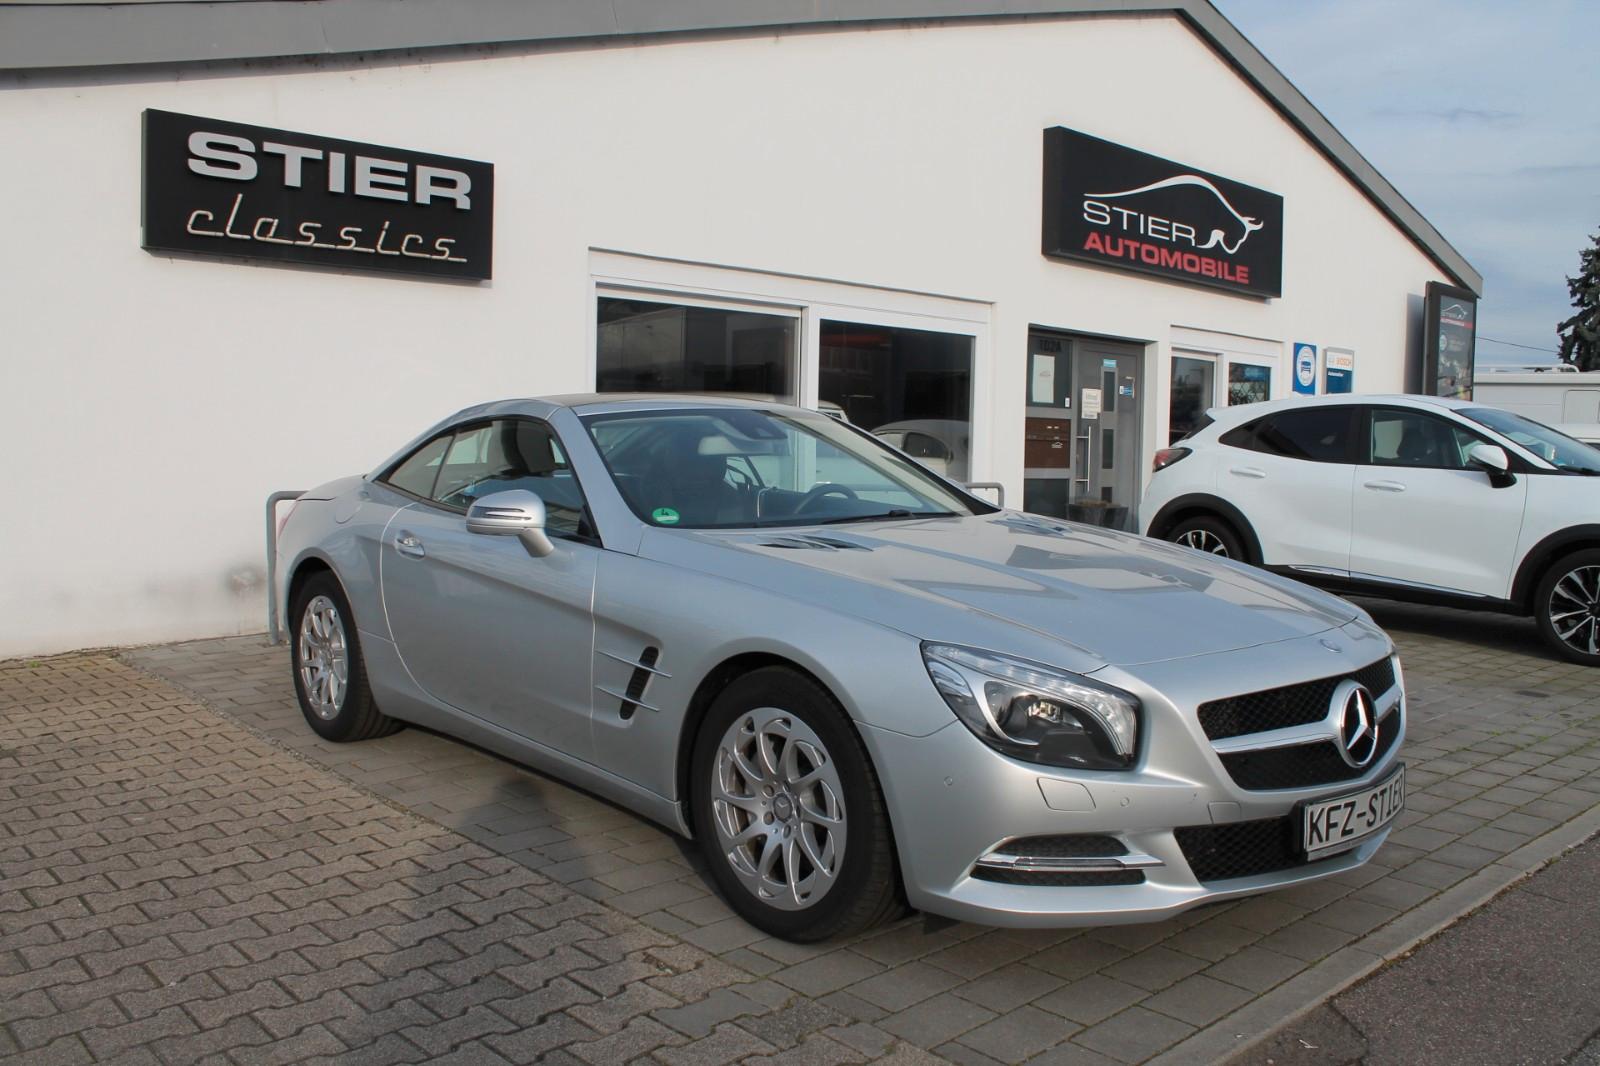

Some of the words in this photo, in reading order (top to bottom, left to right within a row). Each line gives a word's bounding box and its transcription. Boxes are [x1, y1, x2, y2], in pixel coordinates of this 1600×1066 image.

[187, 131, 472, 210] STIER
[187, 193, 468, 263] classics
[1083, 200, 1196, 247] STIER
[1083, 231, 1250, 285] AUTOMOBILE
[1308, 773, 1403, 846] KFZ-STIER
